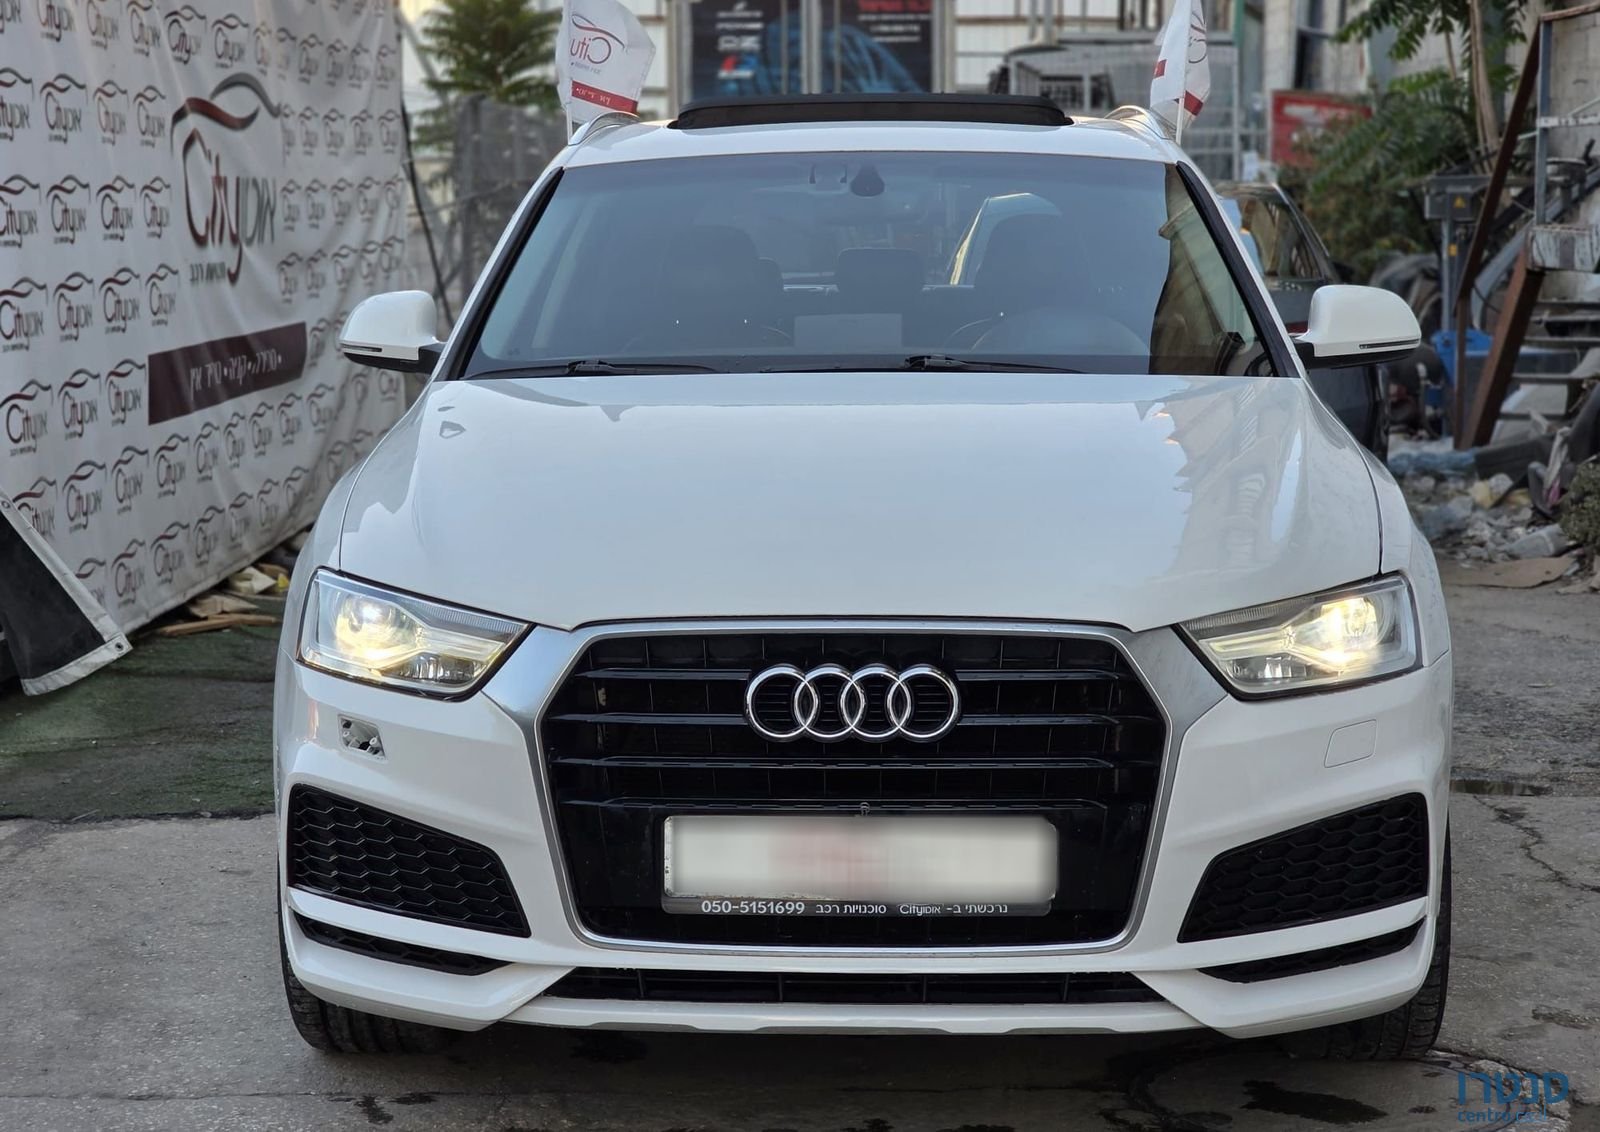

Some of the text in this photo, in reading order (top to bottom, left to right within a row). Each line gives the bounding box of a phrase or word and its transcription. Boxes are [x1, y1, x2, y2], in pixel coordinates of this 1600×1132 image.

[701, 900, 805, 914] 050-5151699
[815, 904, 840, 914] רכב
[965, 903, 1008, 914] נרכשתי
